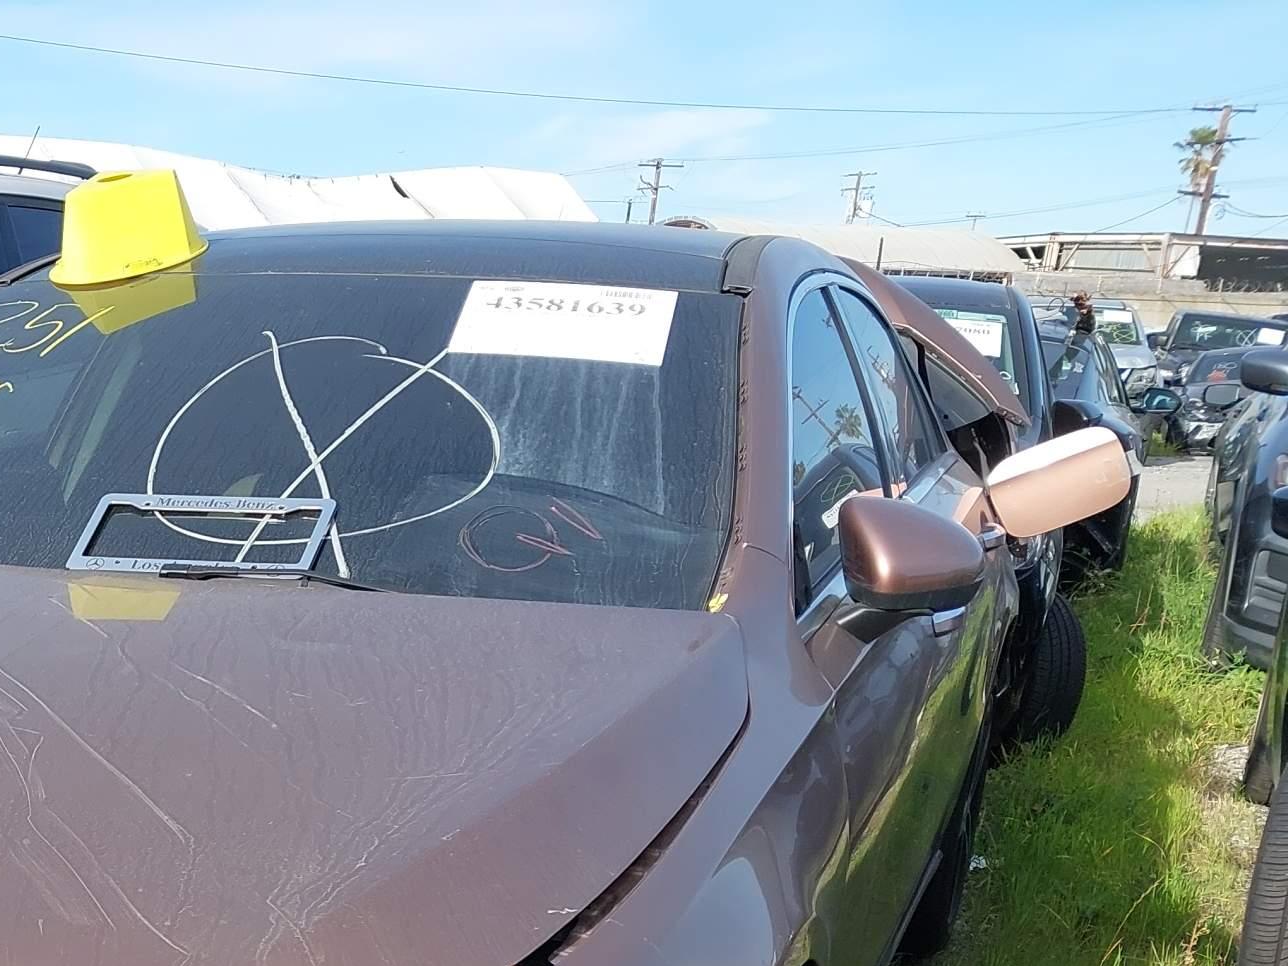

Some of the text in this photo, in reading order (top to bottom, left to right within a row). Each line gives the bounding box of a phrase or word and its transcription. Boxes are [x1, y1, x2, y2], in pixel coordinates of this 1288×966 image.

[485, 295, 647, 317] 43581639
[156, 497, 274, 510] Mercedes Benz
[130, 559, 160, 570] Los
